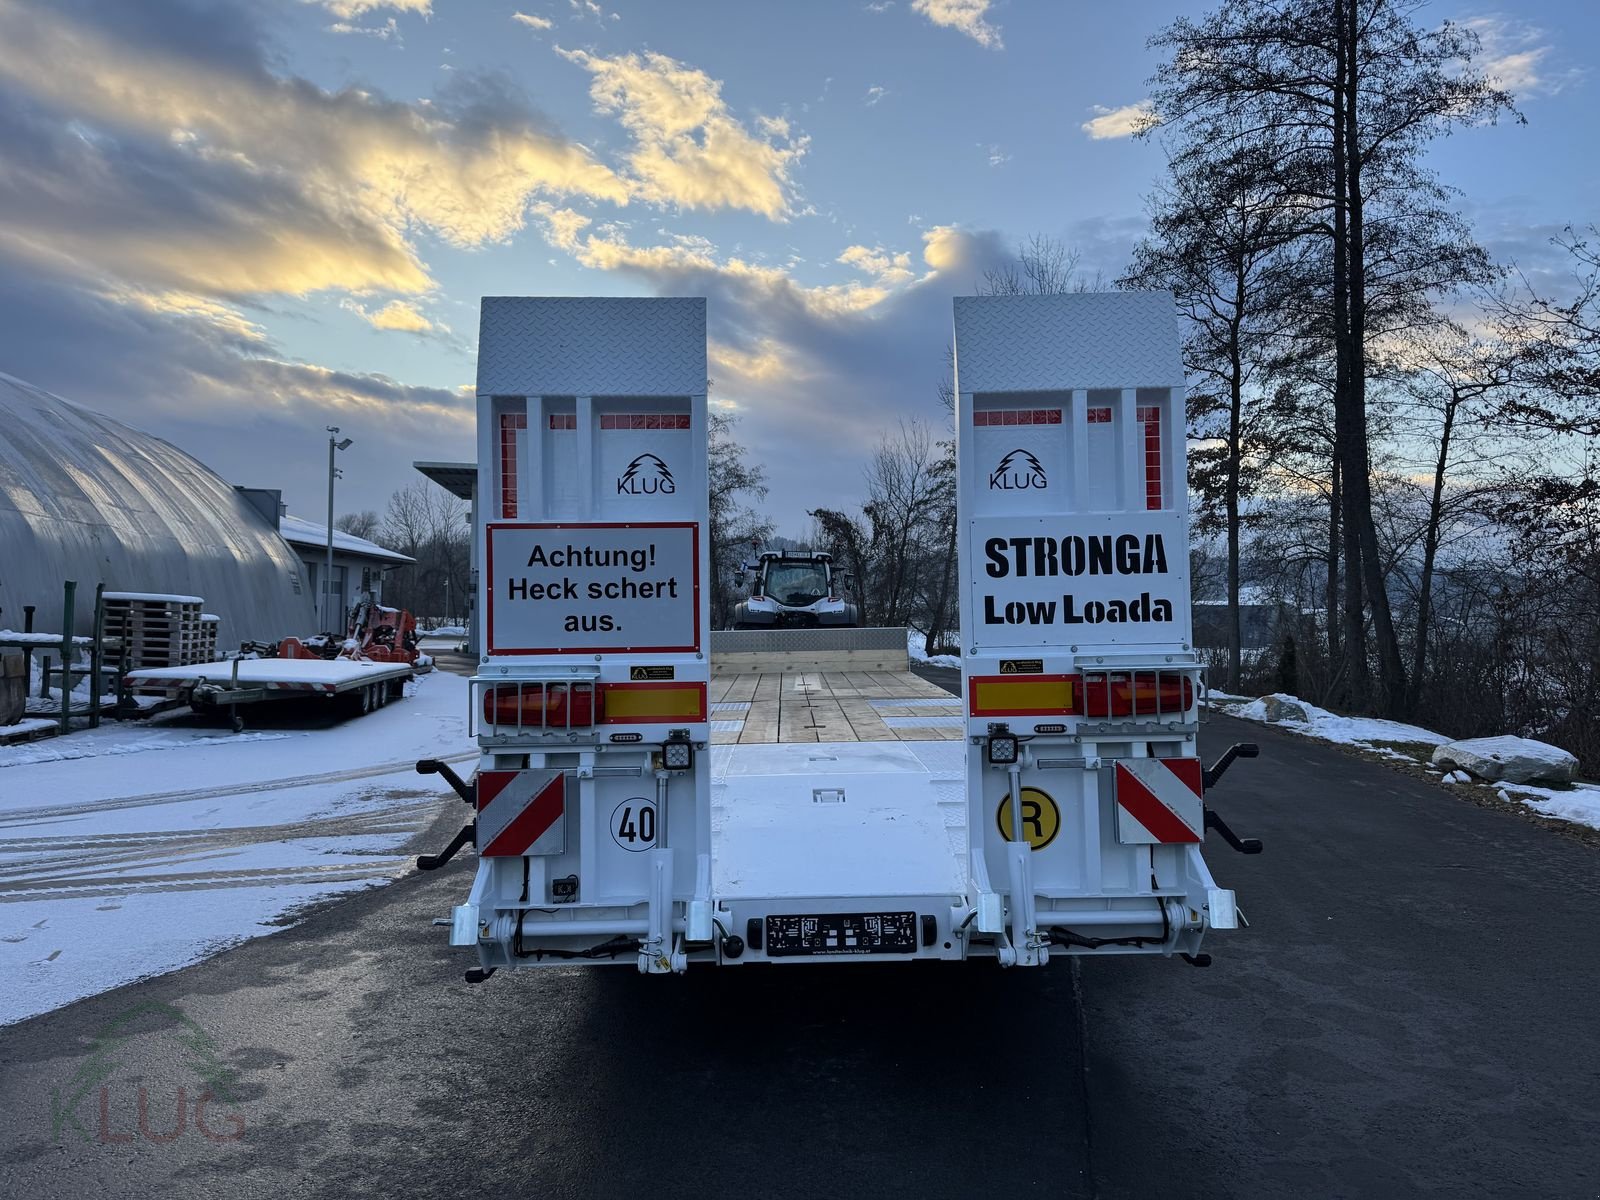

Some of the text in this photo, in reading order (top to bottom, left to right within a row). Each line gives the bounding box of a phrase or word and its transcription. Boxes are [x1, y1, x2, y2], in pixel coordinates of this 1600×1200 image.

[617, 477, 676, 495] KLUG
[990, 472, 1048, 490] KLUG
[527, 544, 657, 572] Achtung!
[984, 533, 1169, 579] STRONGA
[508, 576, 678, 600] Heck schert
[984, 592, 1173, 625] Low Loada
[564, 614, 623, 632] aus.
[618, 806, 656, 843] 40
